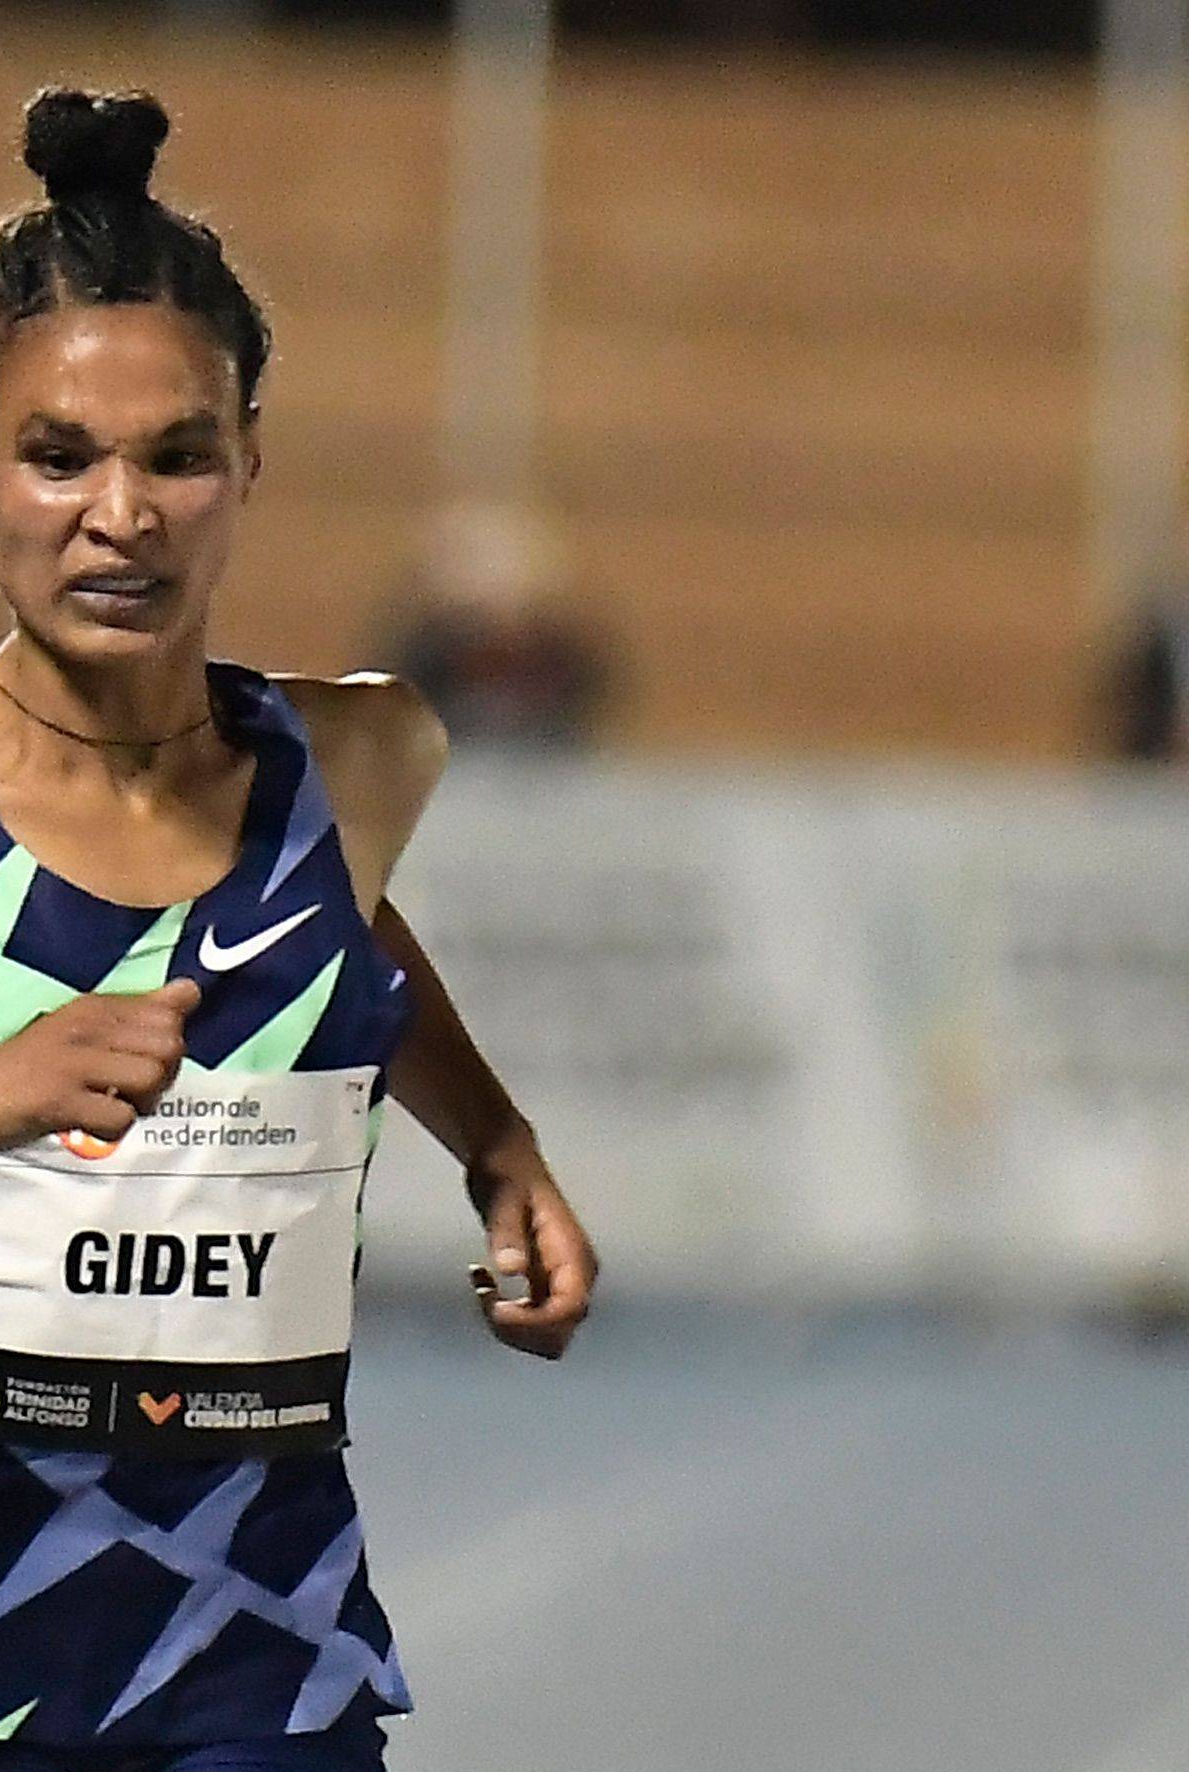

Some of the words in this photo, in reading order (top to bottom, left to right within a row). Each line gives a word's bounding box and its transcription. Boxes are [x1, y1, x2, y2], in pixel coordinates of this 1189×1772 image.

[154, 1095, 261, 1118] ationale
[144, 1123, 297, 1146] nederlanden
[65, 1230, 278, 1298] GIDEY
[6, 1389, 90, 1412] TRINIDAD
[186, 1392, 264, 1410] VALENCIA
[3, 1405, 89, 1427] ALFONSO
